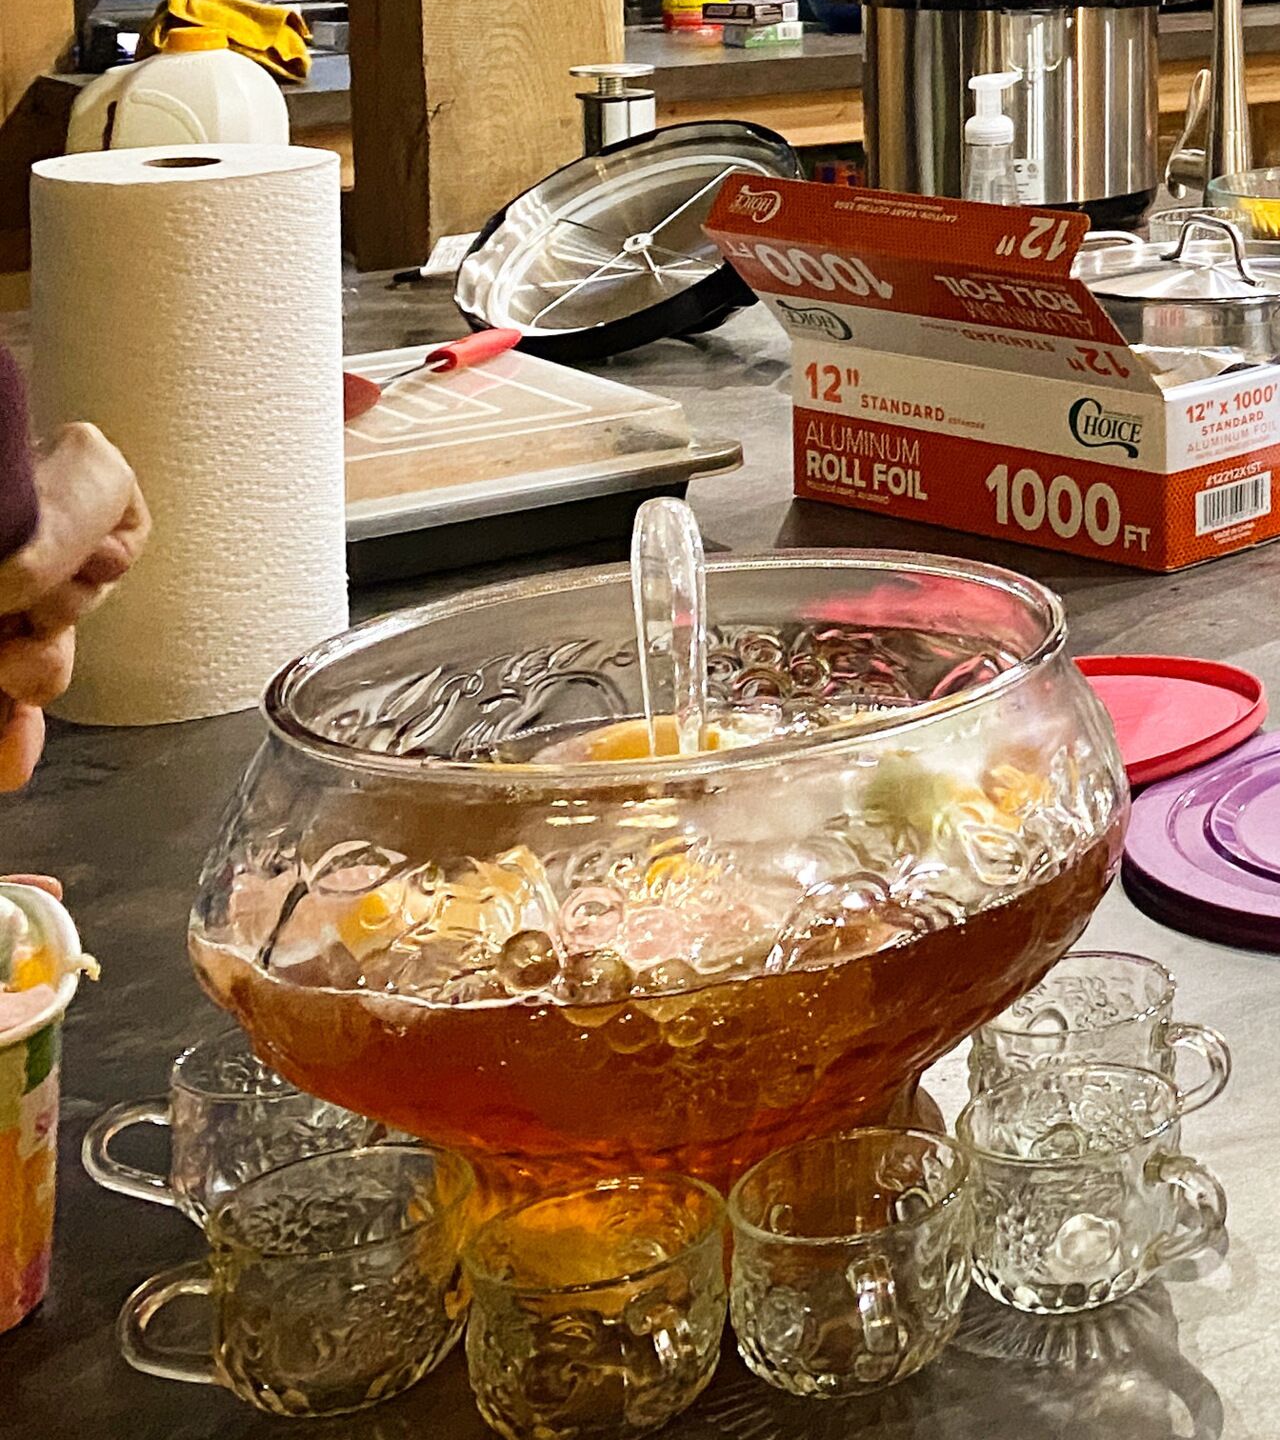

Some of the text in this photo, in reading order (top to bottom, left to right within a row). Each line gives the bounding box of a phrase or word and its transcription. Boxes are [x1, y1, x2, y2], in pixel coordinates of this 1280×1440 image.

[995, 216, 1070, 261] 12"
[726, 240, 893, 300] 1000 FT
[933, 274, 1005, 304] FOIL
[776, 299, 853, 341] CHOICE
[961, 300, 1095, 336] ALUMINUM
[1007, 284, 1082, 315] ROLL
[961, 328, 1056, 353] STANDARD
[1066, 346, 1131, 379] 12"
[805, 362, 946, 423] 12" STANDARD
[1186, 400, 1214, 424] 12"
[1233, 384, 1278, 411] 1000'
[804, 419, 921, 466] ALUMINUM
[1068, 397, 1143, 459] CHOICE
[1187, 430, 1251, 453] ALUMINUM
[1254, 421, 1279, 436] FOIL
[1202, 410, 1264, 437] STANDARD
[805, 449, 868, 488] ROLL
[872, 463, 930, 501] FOIL
[984, 463, 1150, 552] 1000 FT
